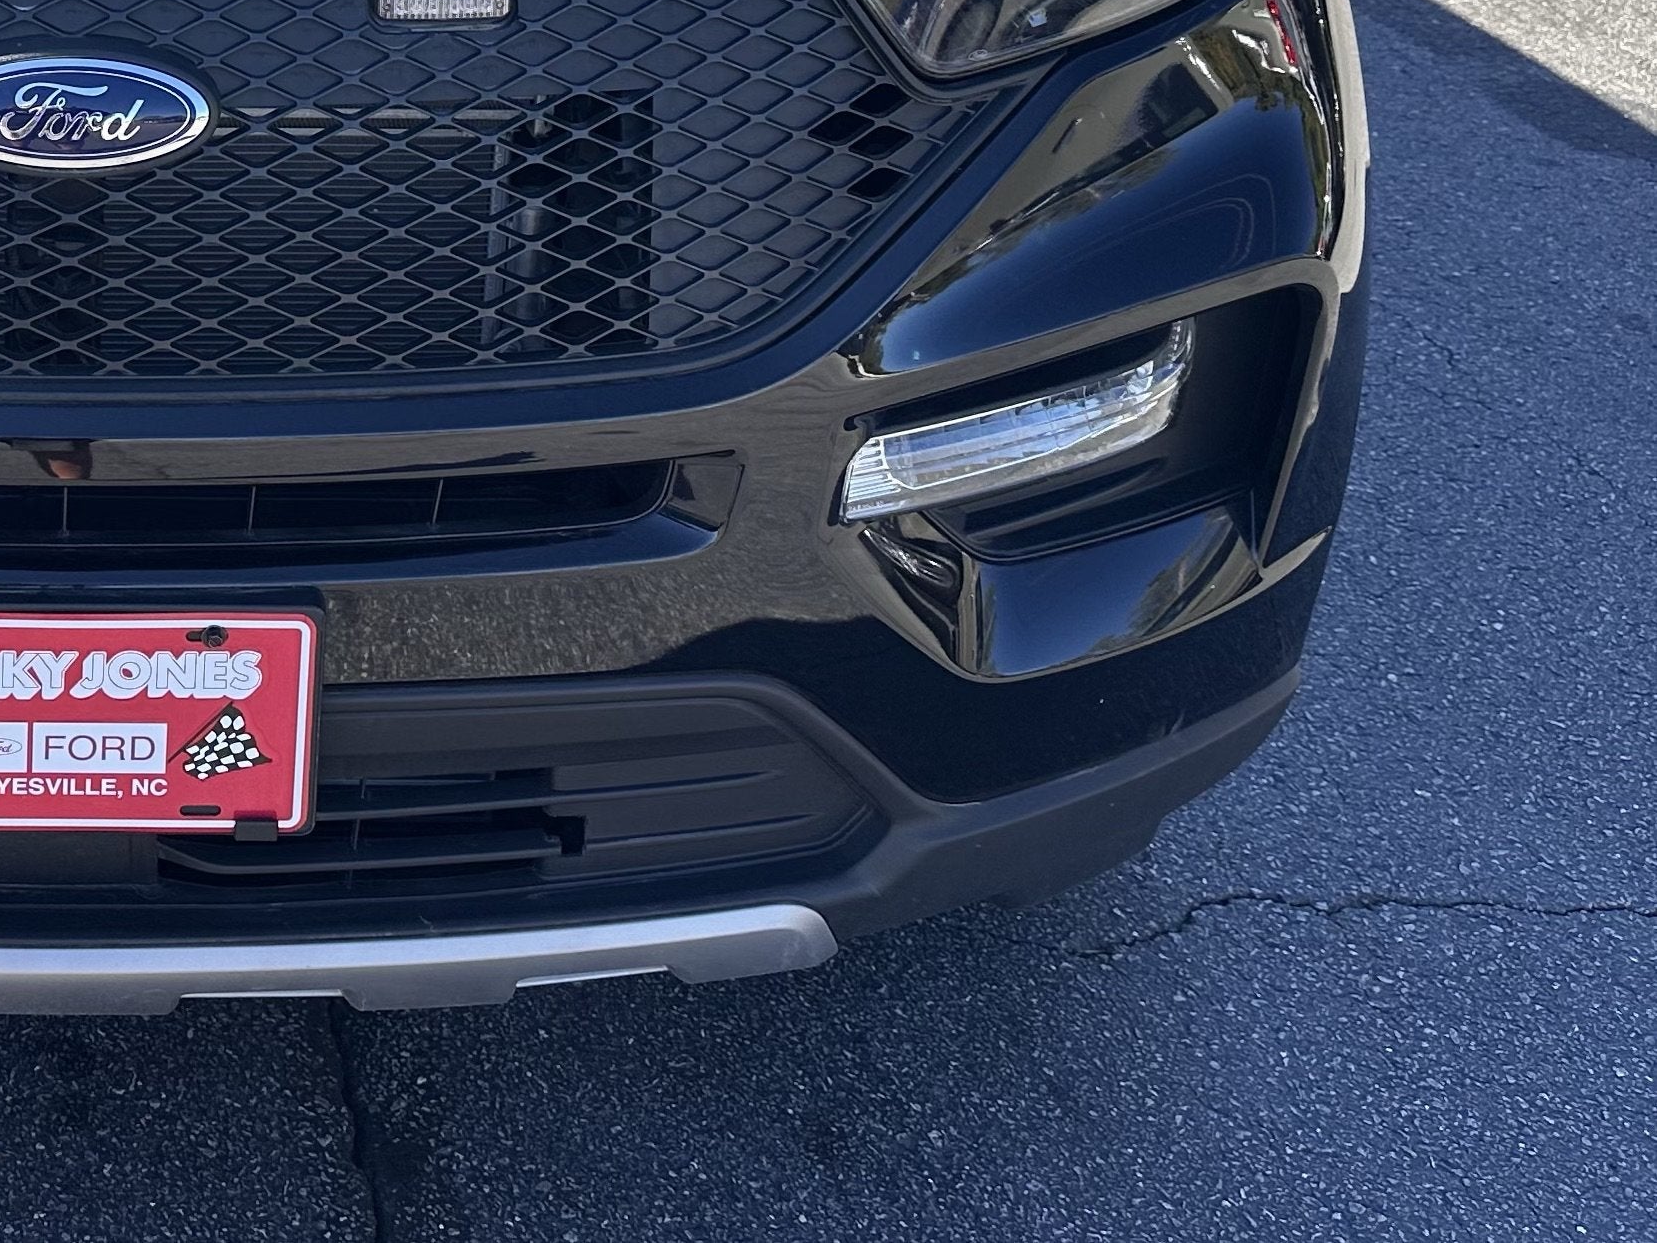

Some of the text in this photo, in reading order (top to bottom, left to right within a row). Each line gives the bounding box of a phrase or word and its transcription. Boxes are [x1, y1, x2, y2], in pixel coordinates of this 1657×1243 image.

[0, 82, 145, 141] Ford
[69, 650, 264, 700] JONES
[44, 735, 156, 761] FORD
[131, 778, 168, 797] NC
